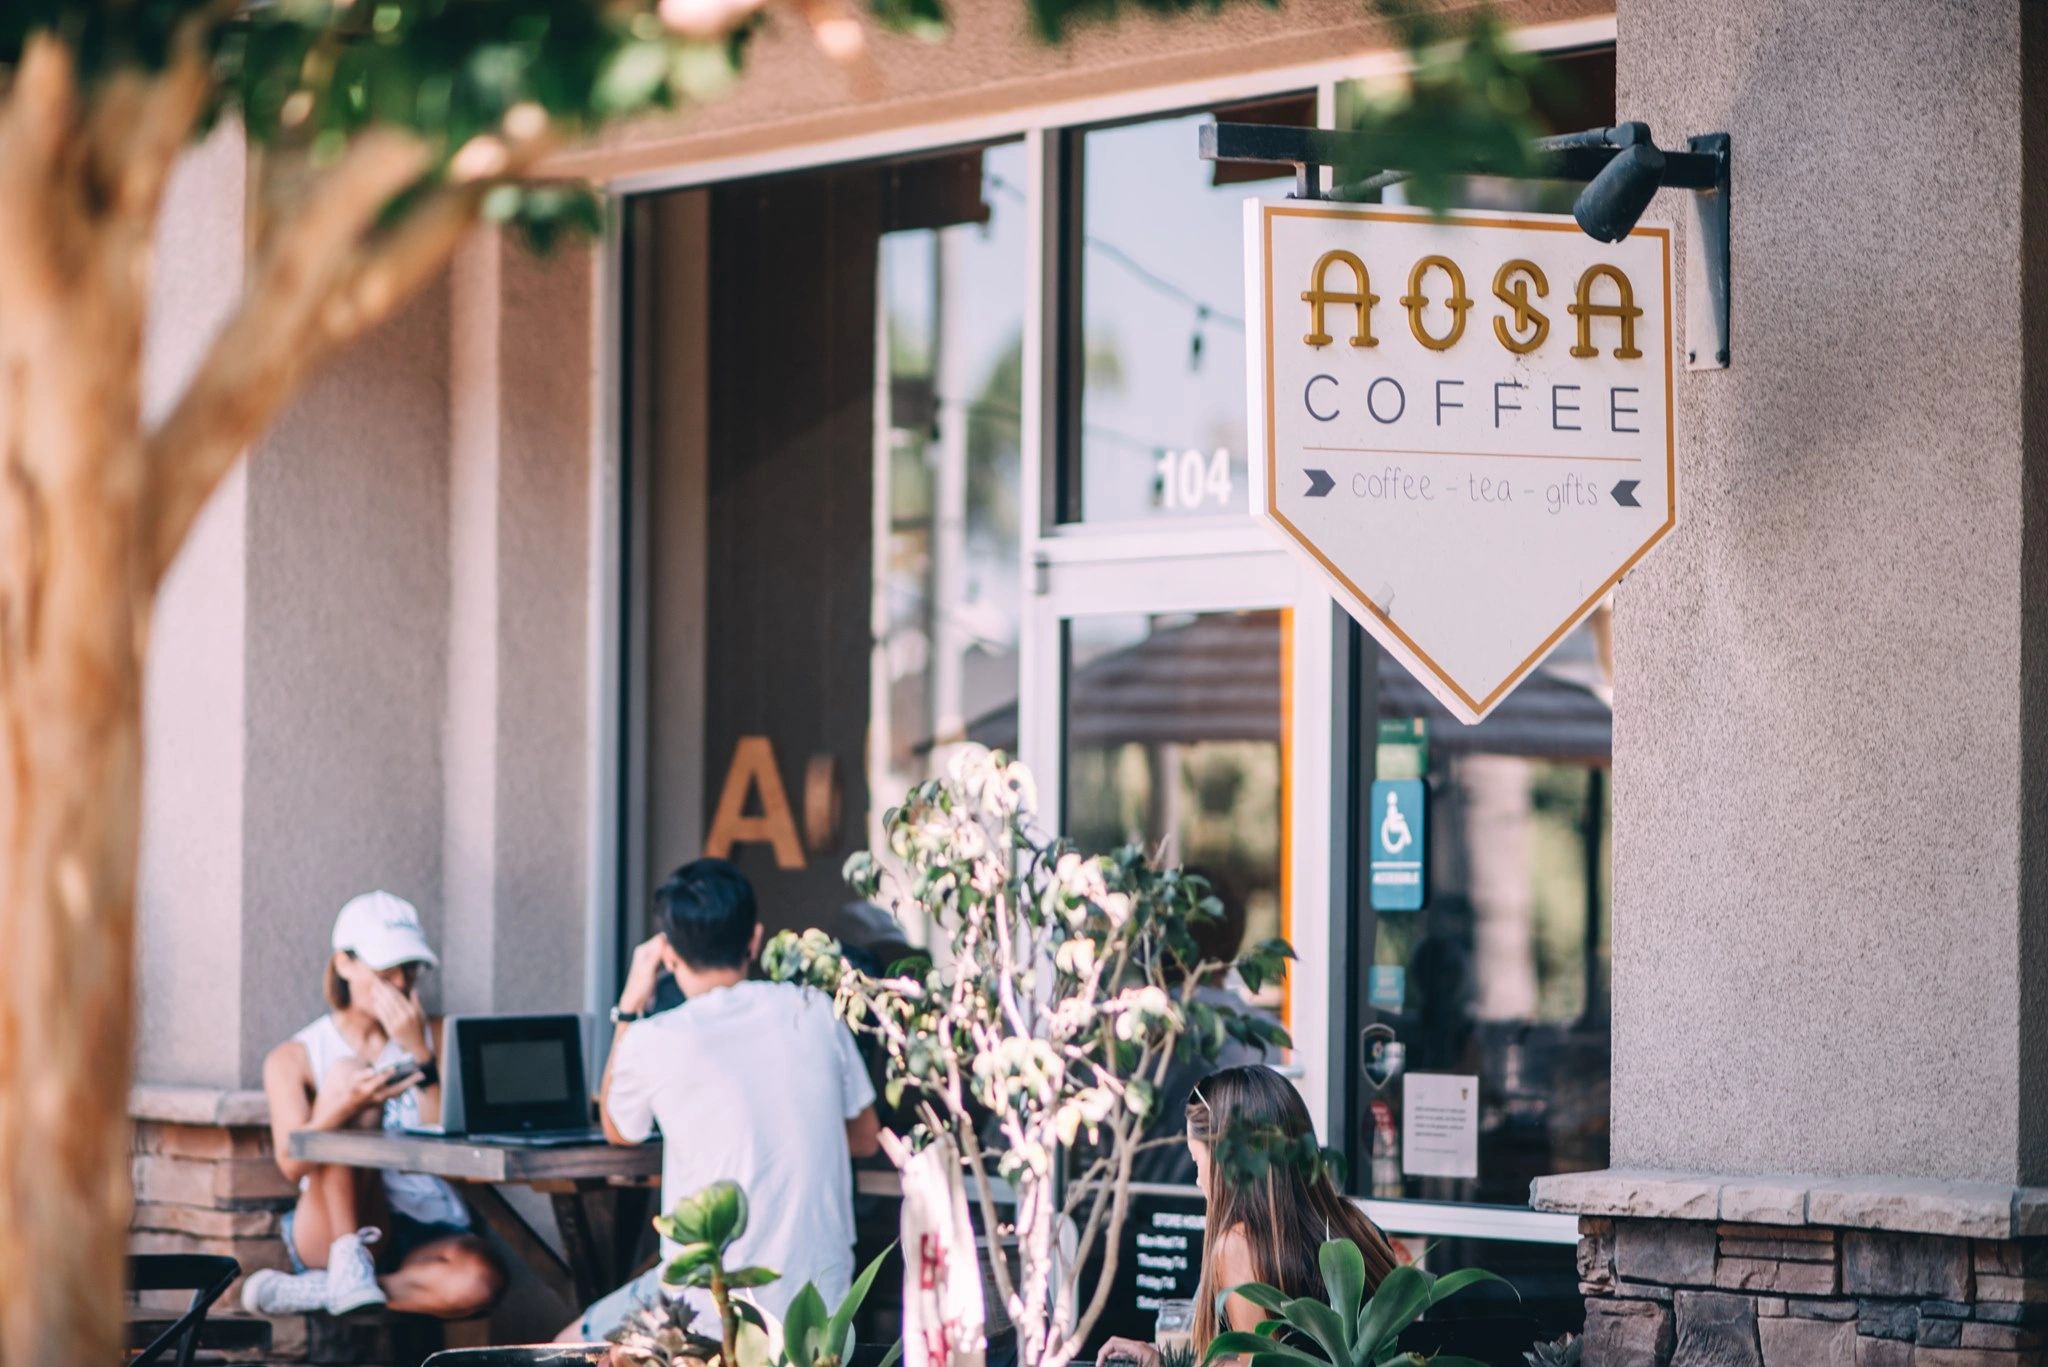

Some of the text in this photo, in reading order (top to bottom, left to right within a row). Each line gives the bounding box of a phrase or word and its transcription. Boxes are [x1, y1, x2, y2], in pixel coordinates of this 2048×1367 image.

[1301, 249, 1644, 359] AOSA
[1304, 374, 1640, 433] COFFEE
[1157, 448, 1232, 508] 104
[1351, 466, 1435, 501] coffee
[1469, 473, 1512, 503] tea
[1546, 472, 1598, 515] gifts
